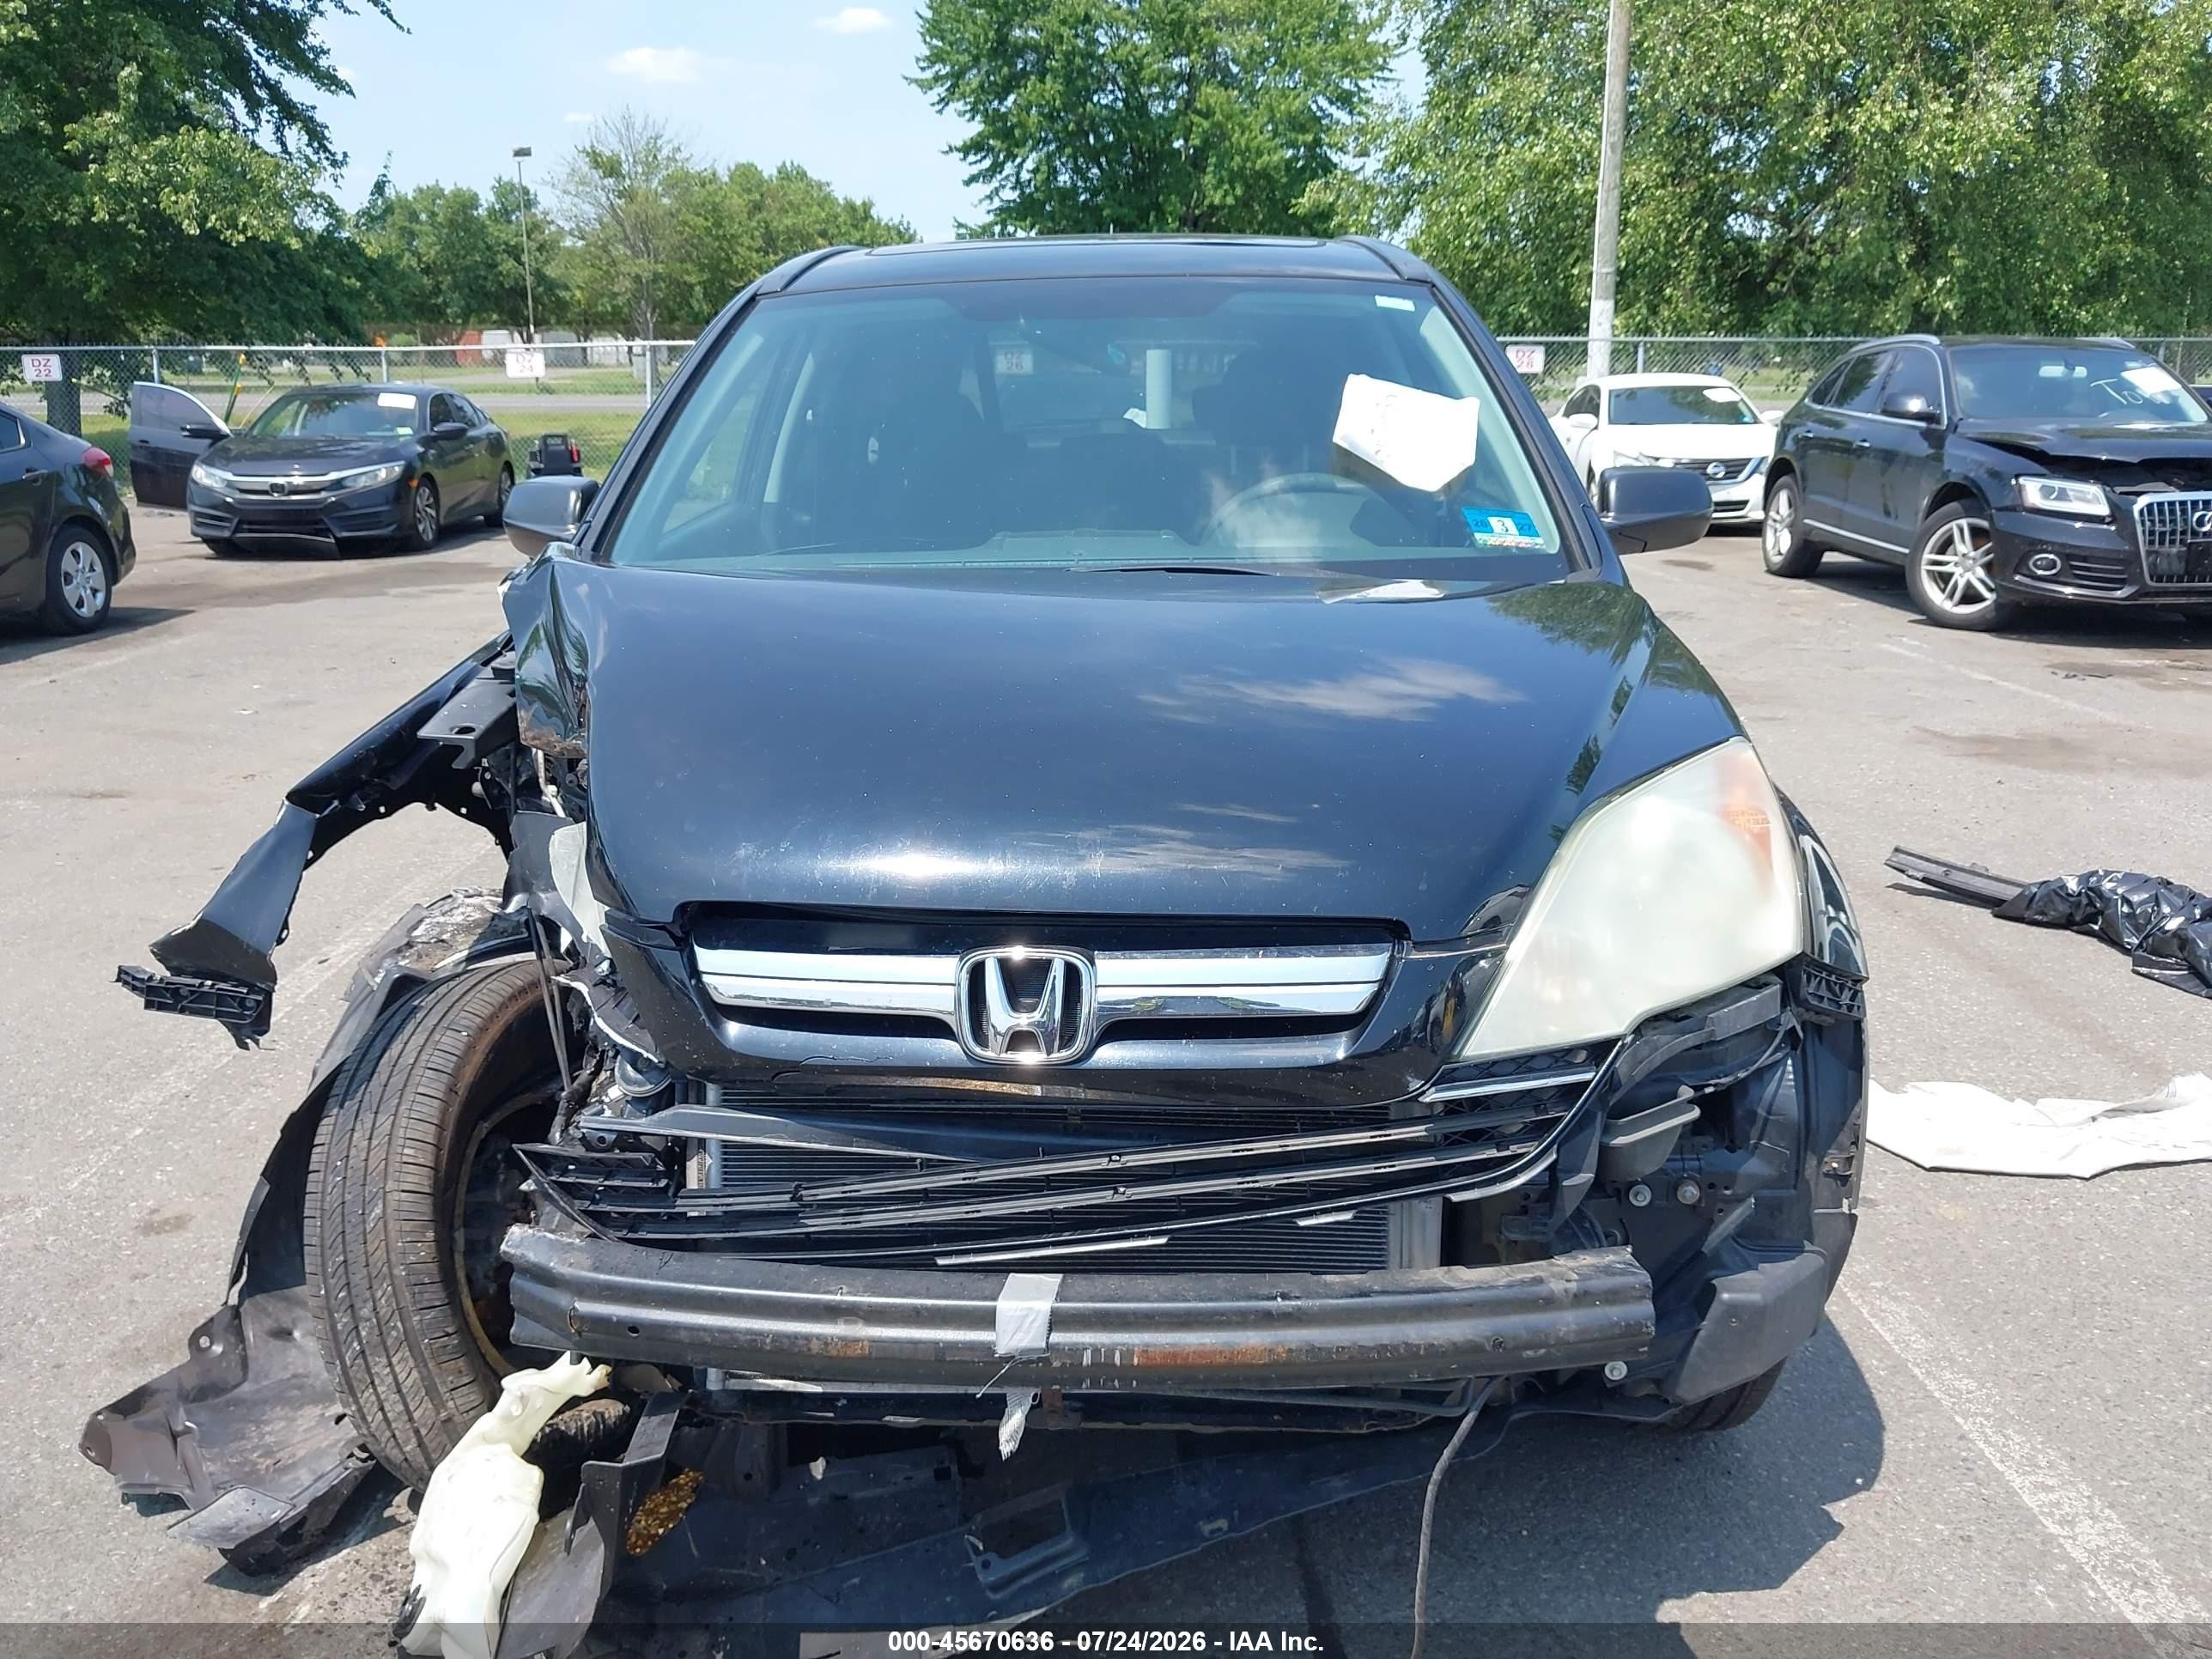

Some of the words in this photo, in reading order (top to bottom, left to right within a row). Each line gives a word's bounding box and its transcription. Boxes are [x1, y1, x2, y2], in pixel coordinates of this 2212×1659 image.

[1516, 349, 1535, 360] DZ
[31, 358, 52, 368] DZ
[33, 368, 52, 378] 22
[1497, 520, 1509, 532] 3
